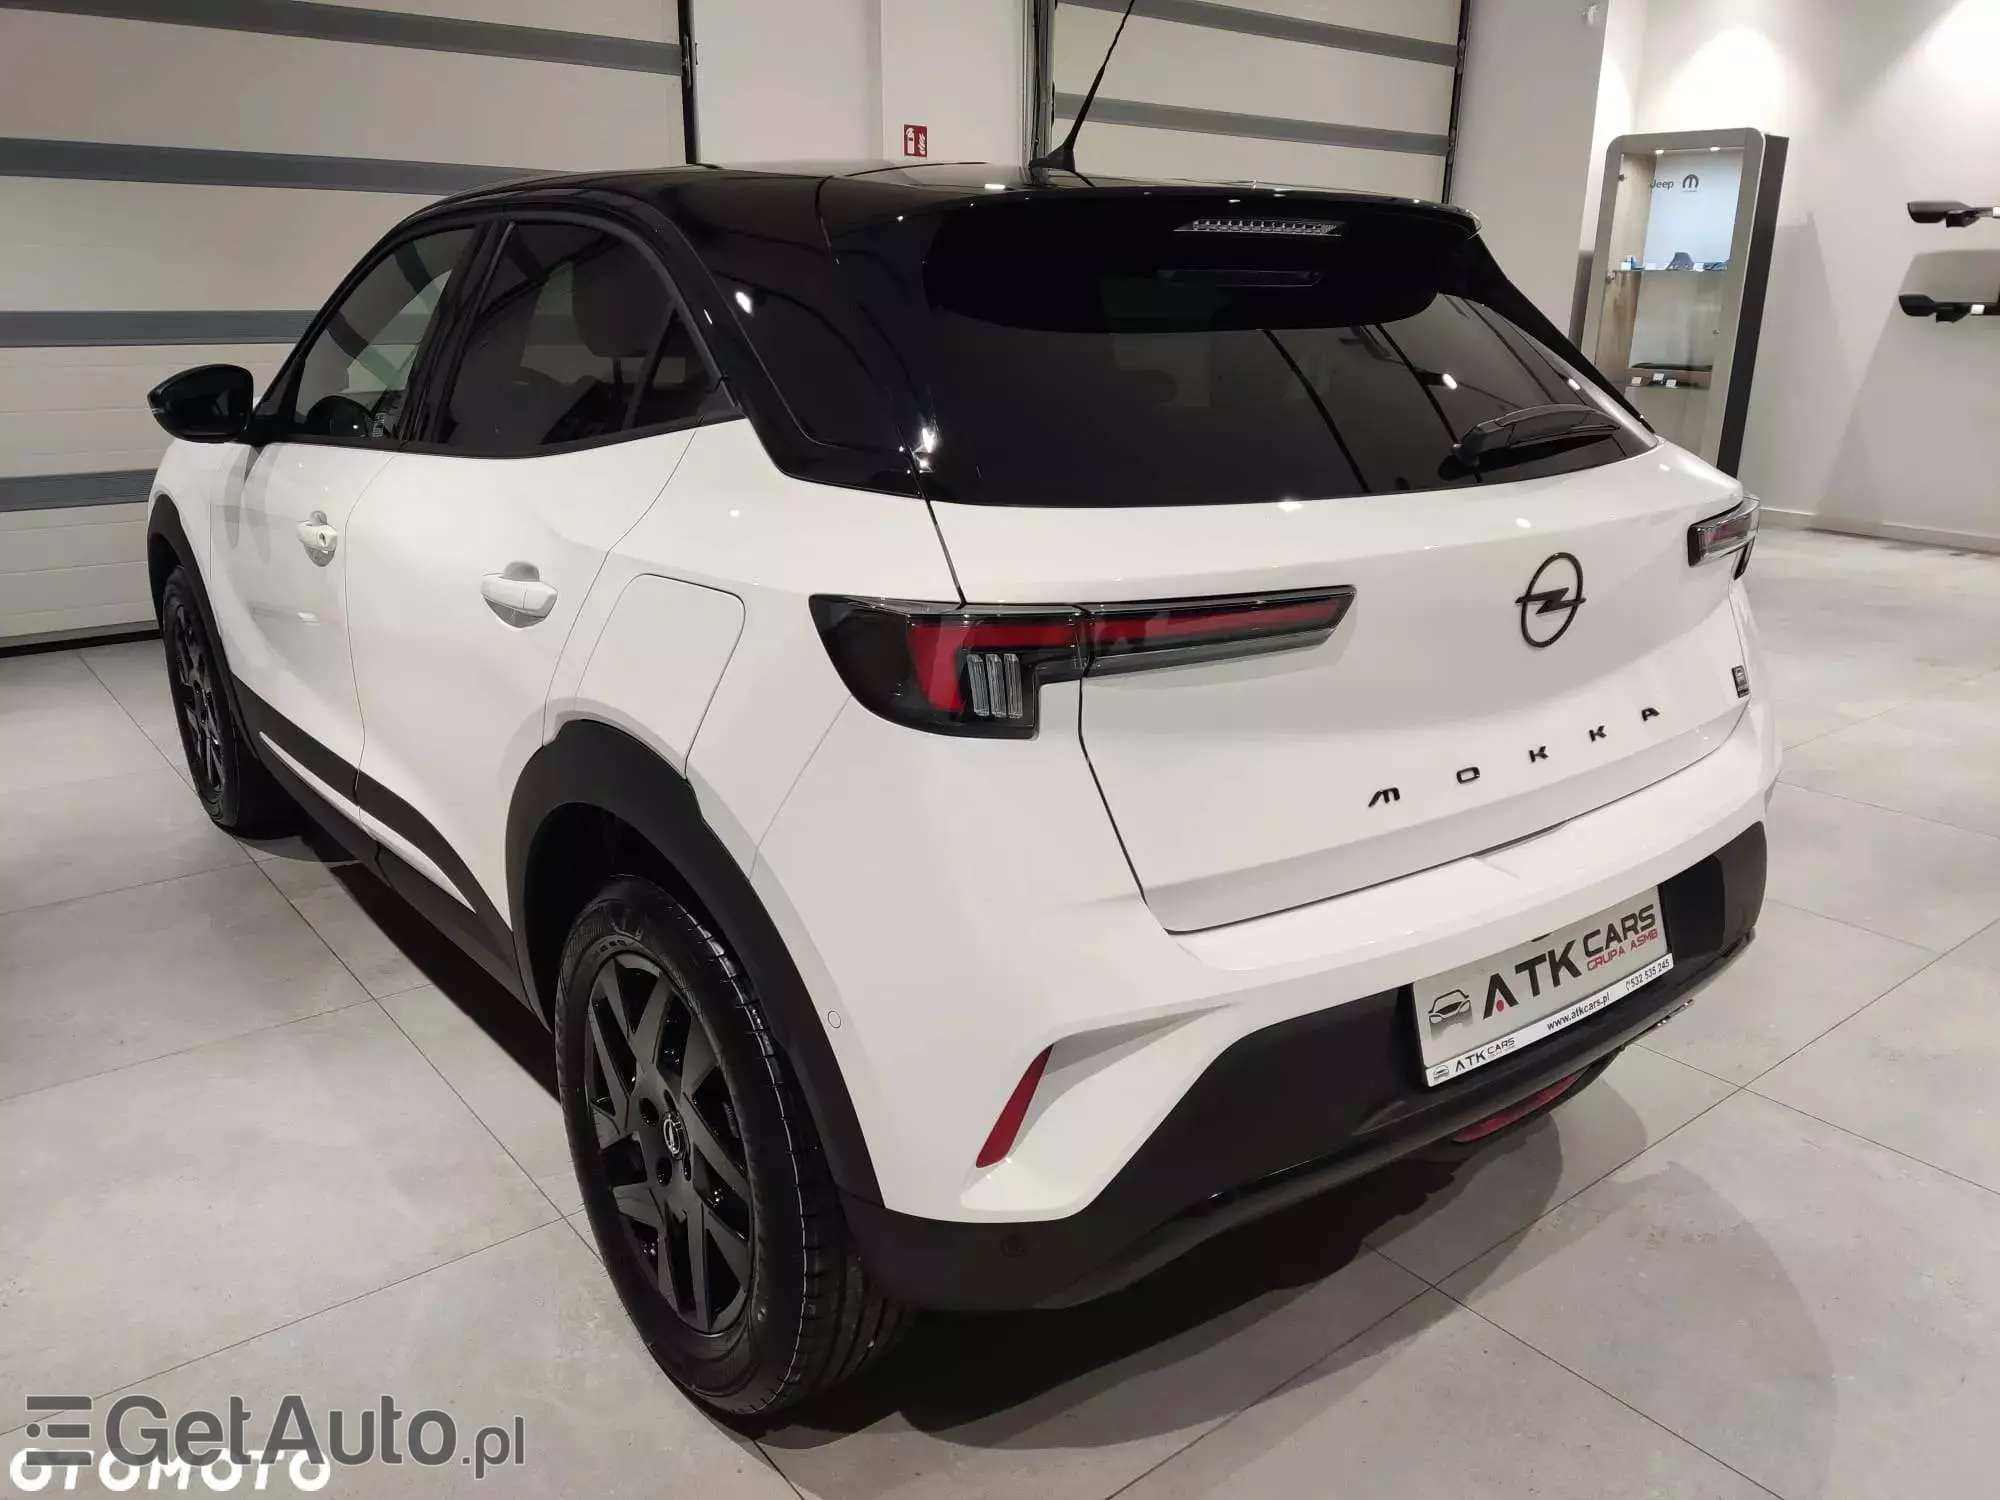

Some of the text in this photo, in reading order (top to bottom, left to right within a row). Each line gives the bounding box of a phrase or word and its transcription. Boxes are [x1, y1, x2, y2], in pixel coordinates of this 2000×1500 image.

[1650, 179, 1674, 190] Jeep
[1368, 705, 1661, 808] MOKKA
[1630, 928, 1659, 951] ASMB
[1483, 903, 1656, 1020] ATK CARS
[1658, 958, 1670, 972] 245
[1546, 991, 1610, 1031] www.atkcars.pl
[1455, 1049, 1486, 1073] ATK
[1487, 1037, 1515, 1055] CARS
